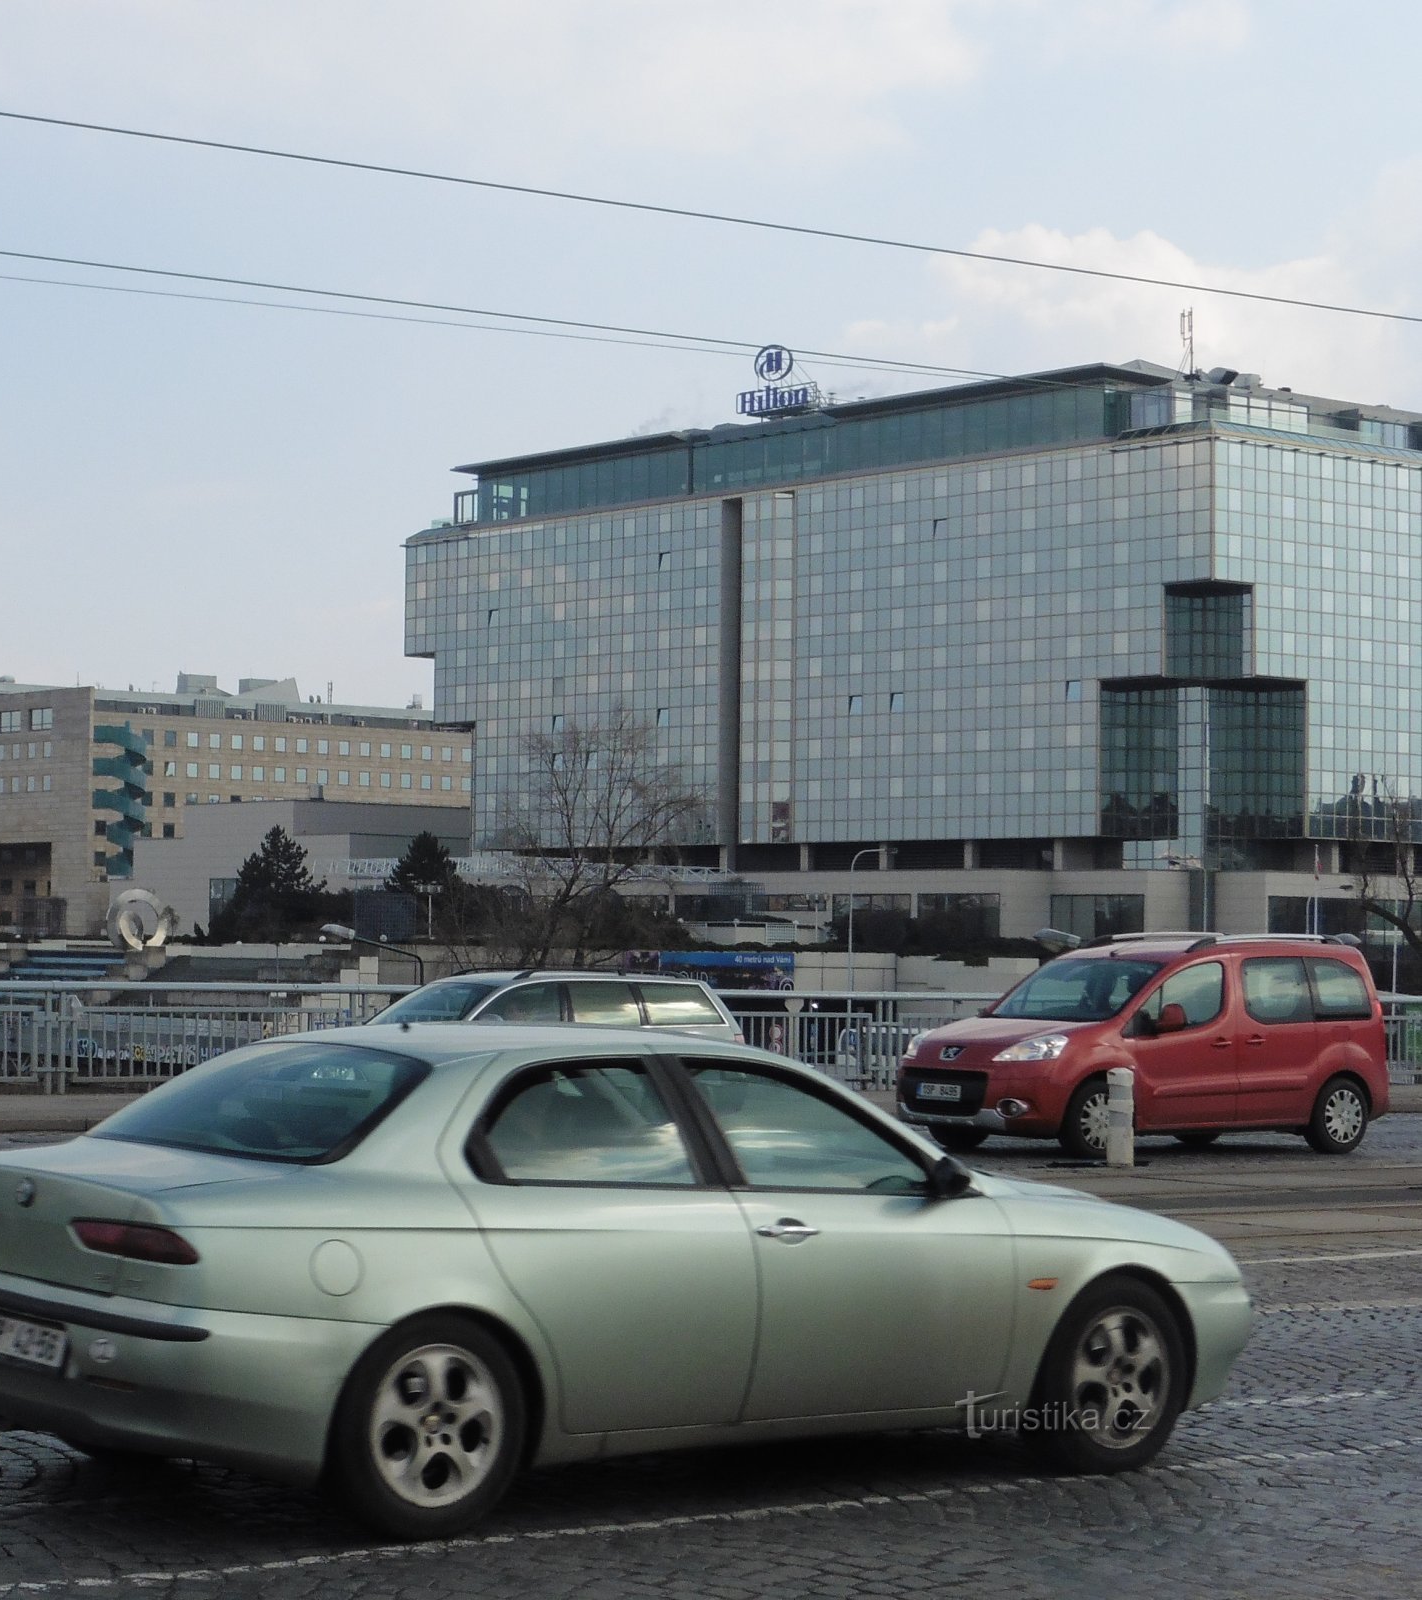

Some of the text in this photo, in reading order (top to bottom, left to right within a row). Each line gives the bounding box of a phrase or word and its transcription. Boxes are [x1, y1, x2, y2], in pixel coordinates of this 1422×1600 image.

[740, 385, 809, 414] Hilton
[734, 955, 743, 963] 40
[763, 955, 775, 963] nad
